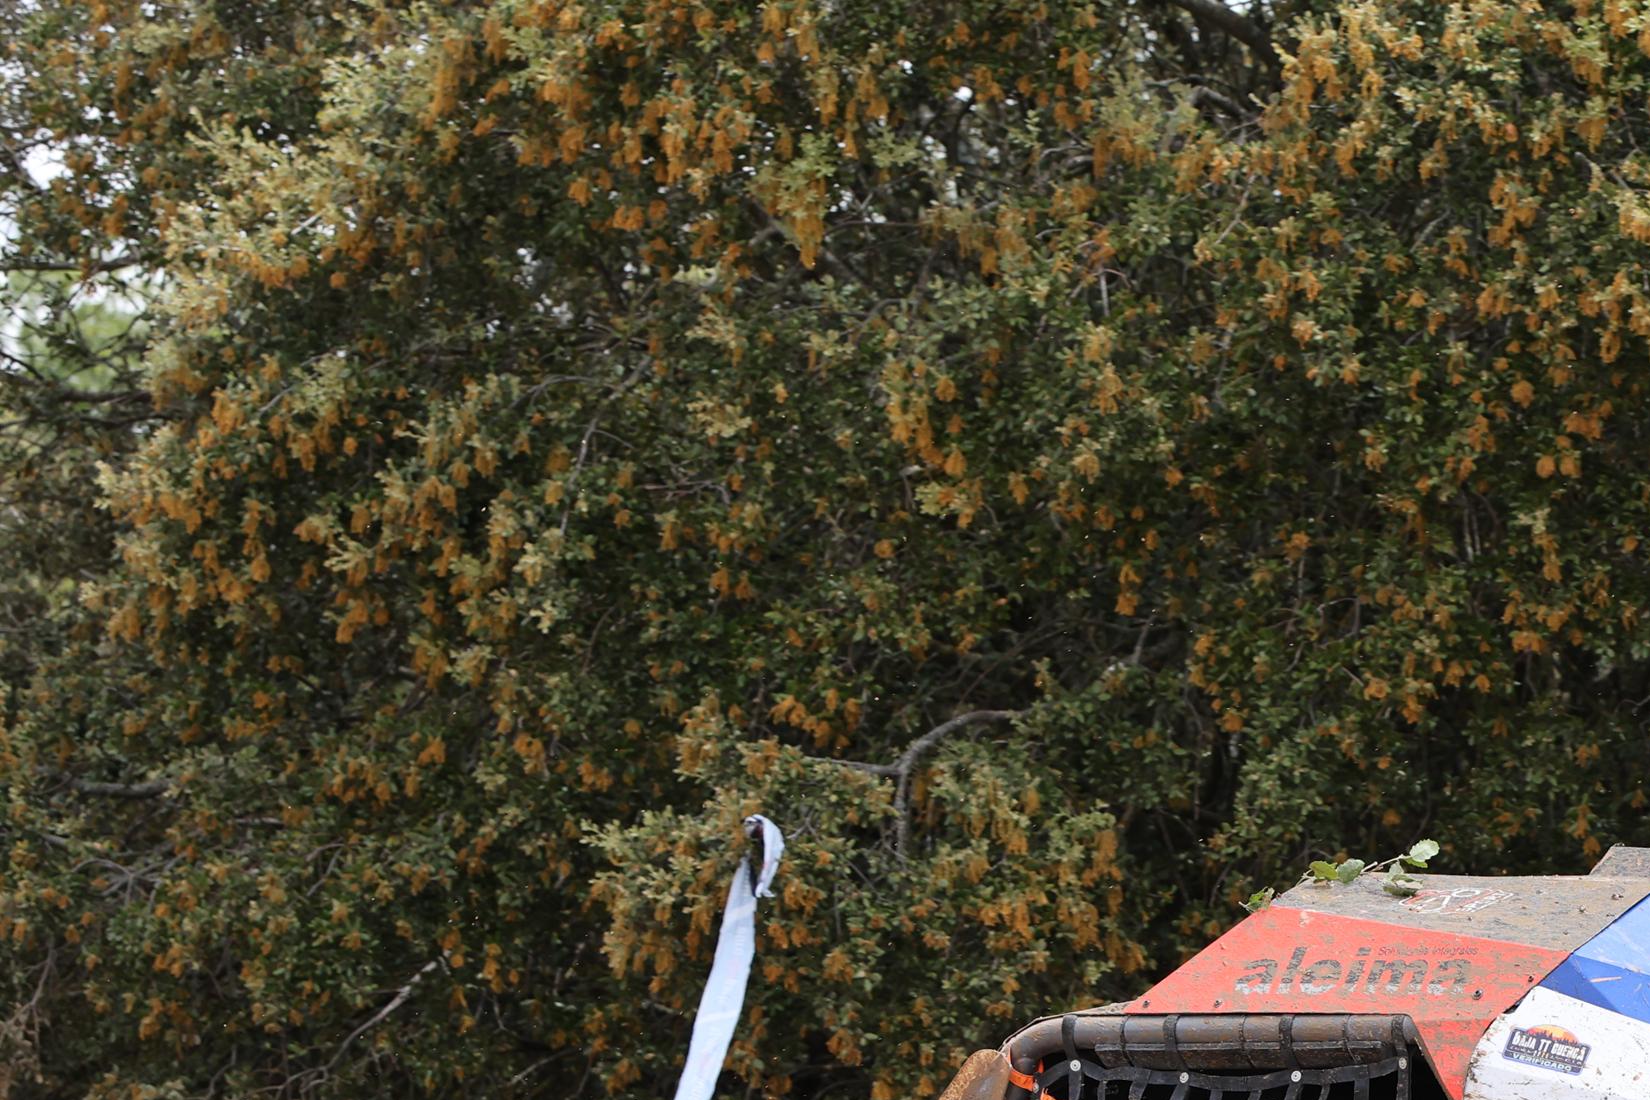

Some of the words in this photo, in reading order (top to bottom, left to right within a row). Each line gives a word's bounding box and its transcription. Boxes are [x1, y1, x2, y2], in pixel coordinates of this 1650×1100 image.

[1235, 947, 1471, 995] aleima
[1512, 1031, 1537, 1050] BAJA
[1538, 1038, 1552, 1052] TT
[1551, 1043, 1587, 1061] CUENCA
[1512, 1052, 1572, 1072] VERIFICADO
